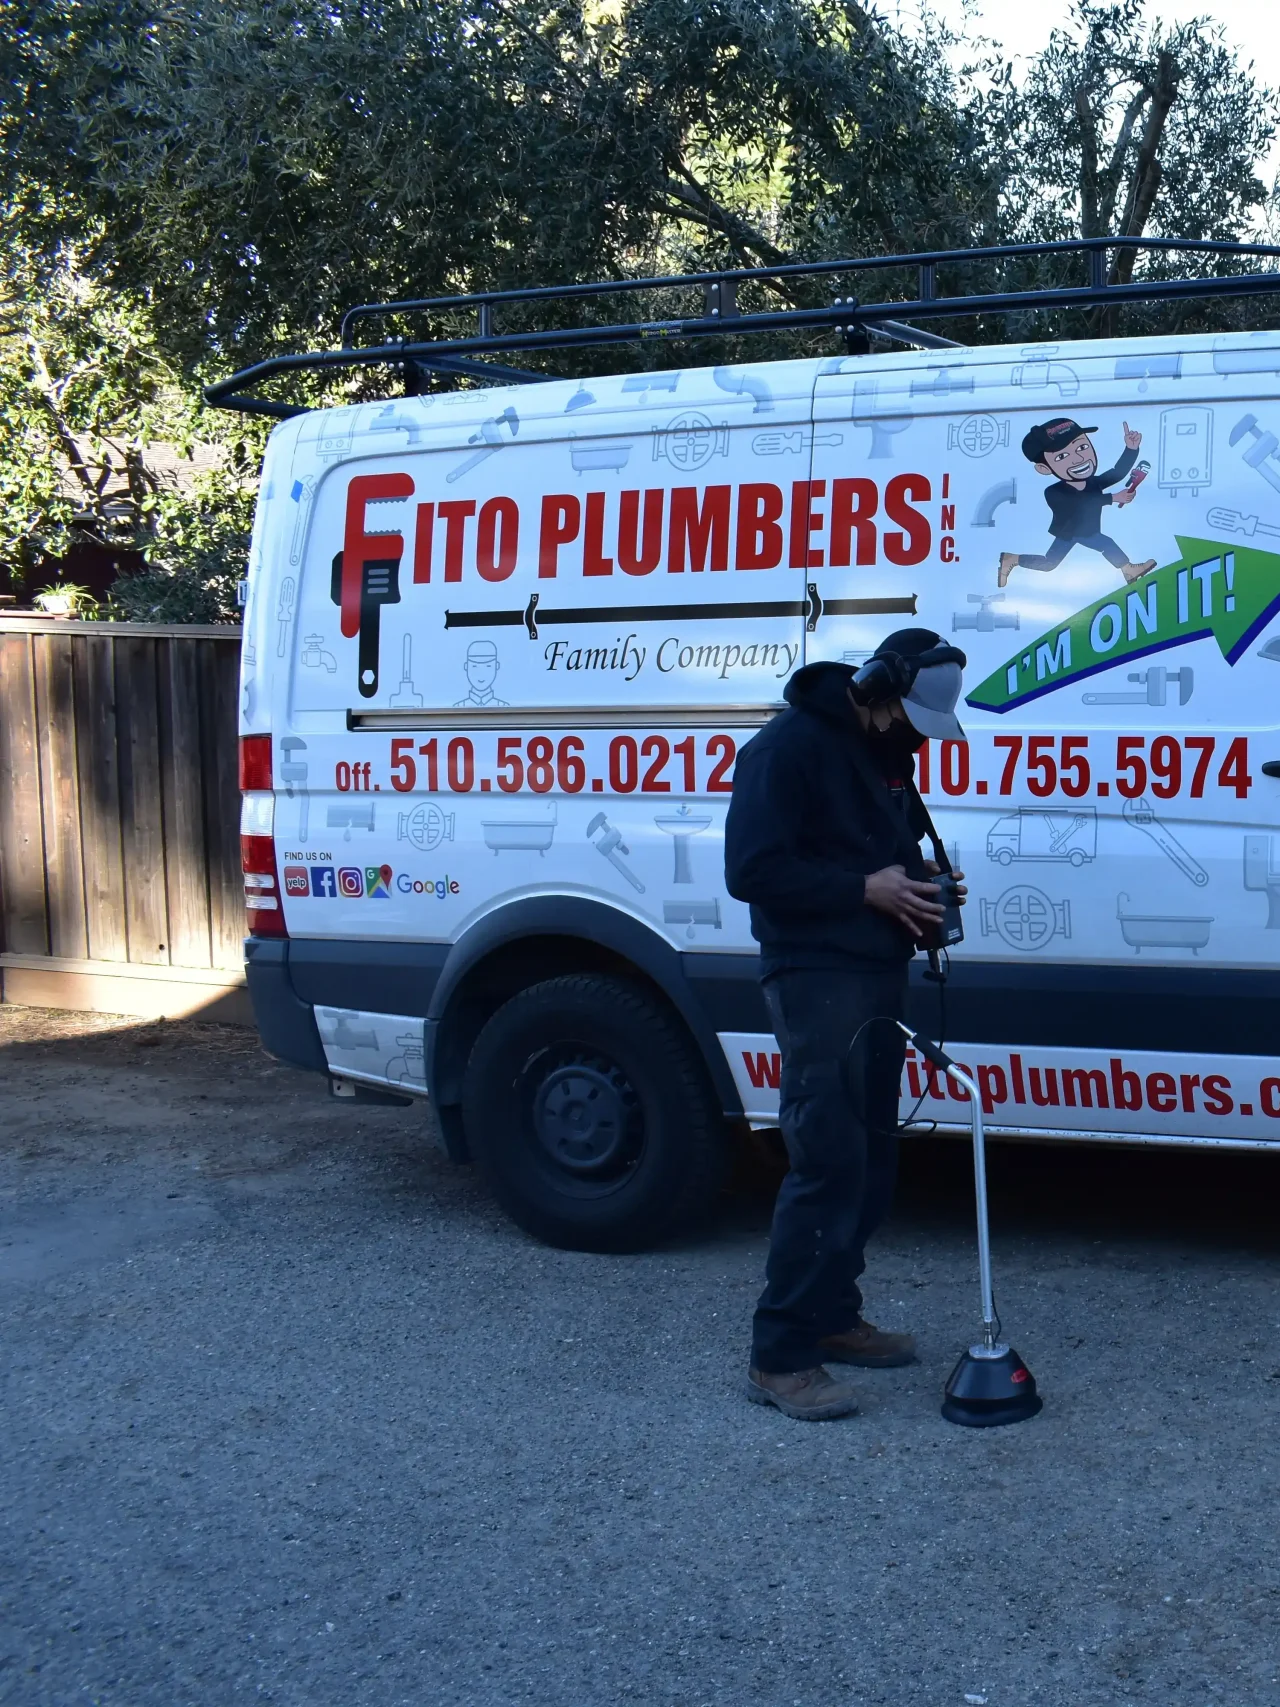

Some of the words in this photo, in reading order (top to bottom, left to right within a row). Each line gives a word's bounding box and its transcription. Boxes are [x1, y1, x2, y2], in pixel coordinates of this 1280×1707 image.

[341, 472, 520, 638] FITO
[538, 473, 932, 579] PLUMBERS
[940, 473, 960, 563] INC.
[1089, 580, 1158, 653] ON
[1176, 551, 1236, 624] IT!
[544, 633, 647, 681] Family
[656, 637, 799, 679] Company
[335, 760, 380, 793] Off.
[390, 734, 736, 793] 510.586.0212
[914, 736, 1252, 798] 10.755.5974
[284, 851, 304, 861] FIND
[305, 852, 318, 861] US
[319, 852, 332, 861] ON
[287, 876, 306, 890] yelp
[396, 873, 460, 900] Google
